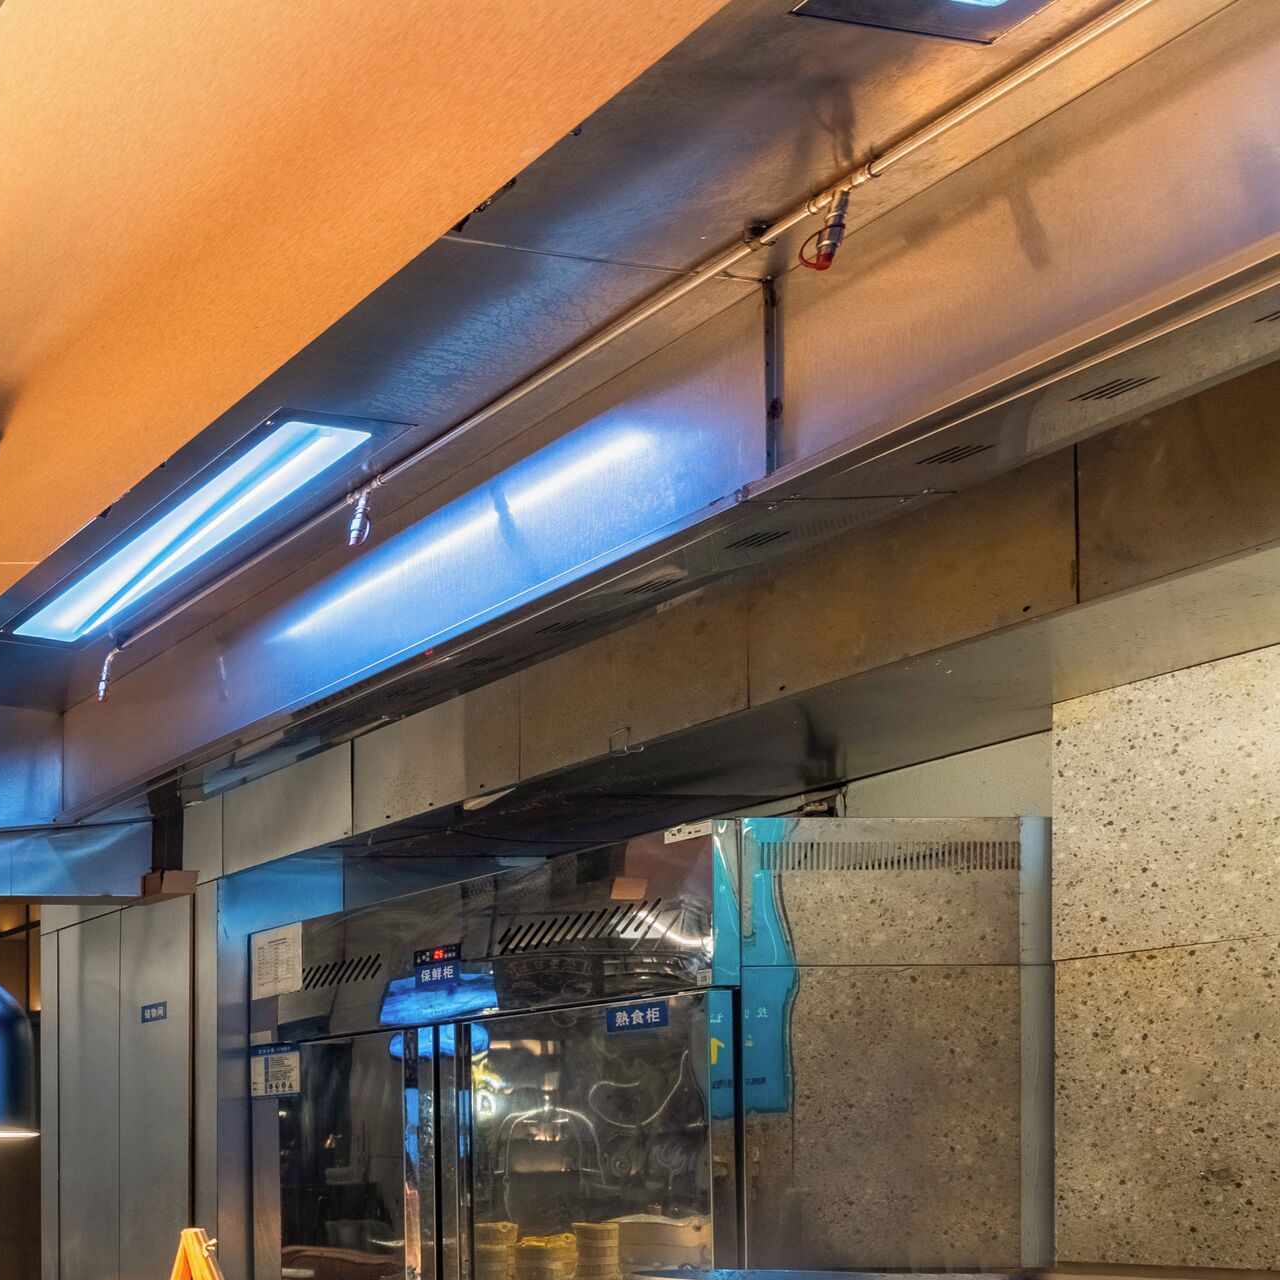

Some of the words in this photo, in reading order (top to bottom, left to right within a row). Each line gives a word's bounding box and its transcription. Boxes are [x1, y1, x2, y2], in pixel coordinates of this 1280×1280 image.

[420, 965, 454, 983] 保鲜柜
[615, 1007, 661, 1027] 熟食柜
